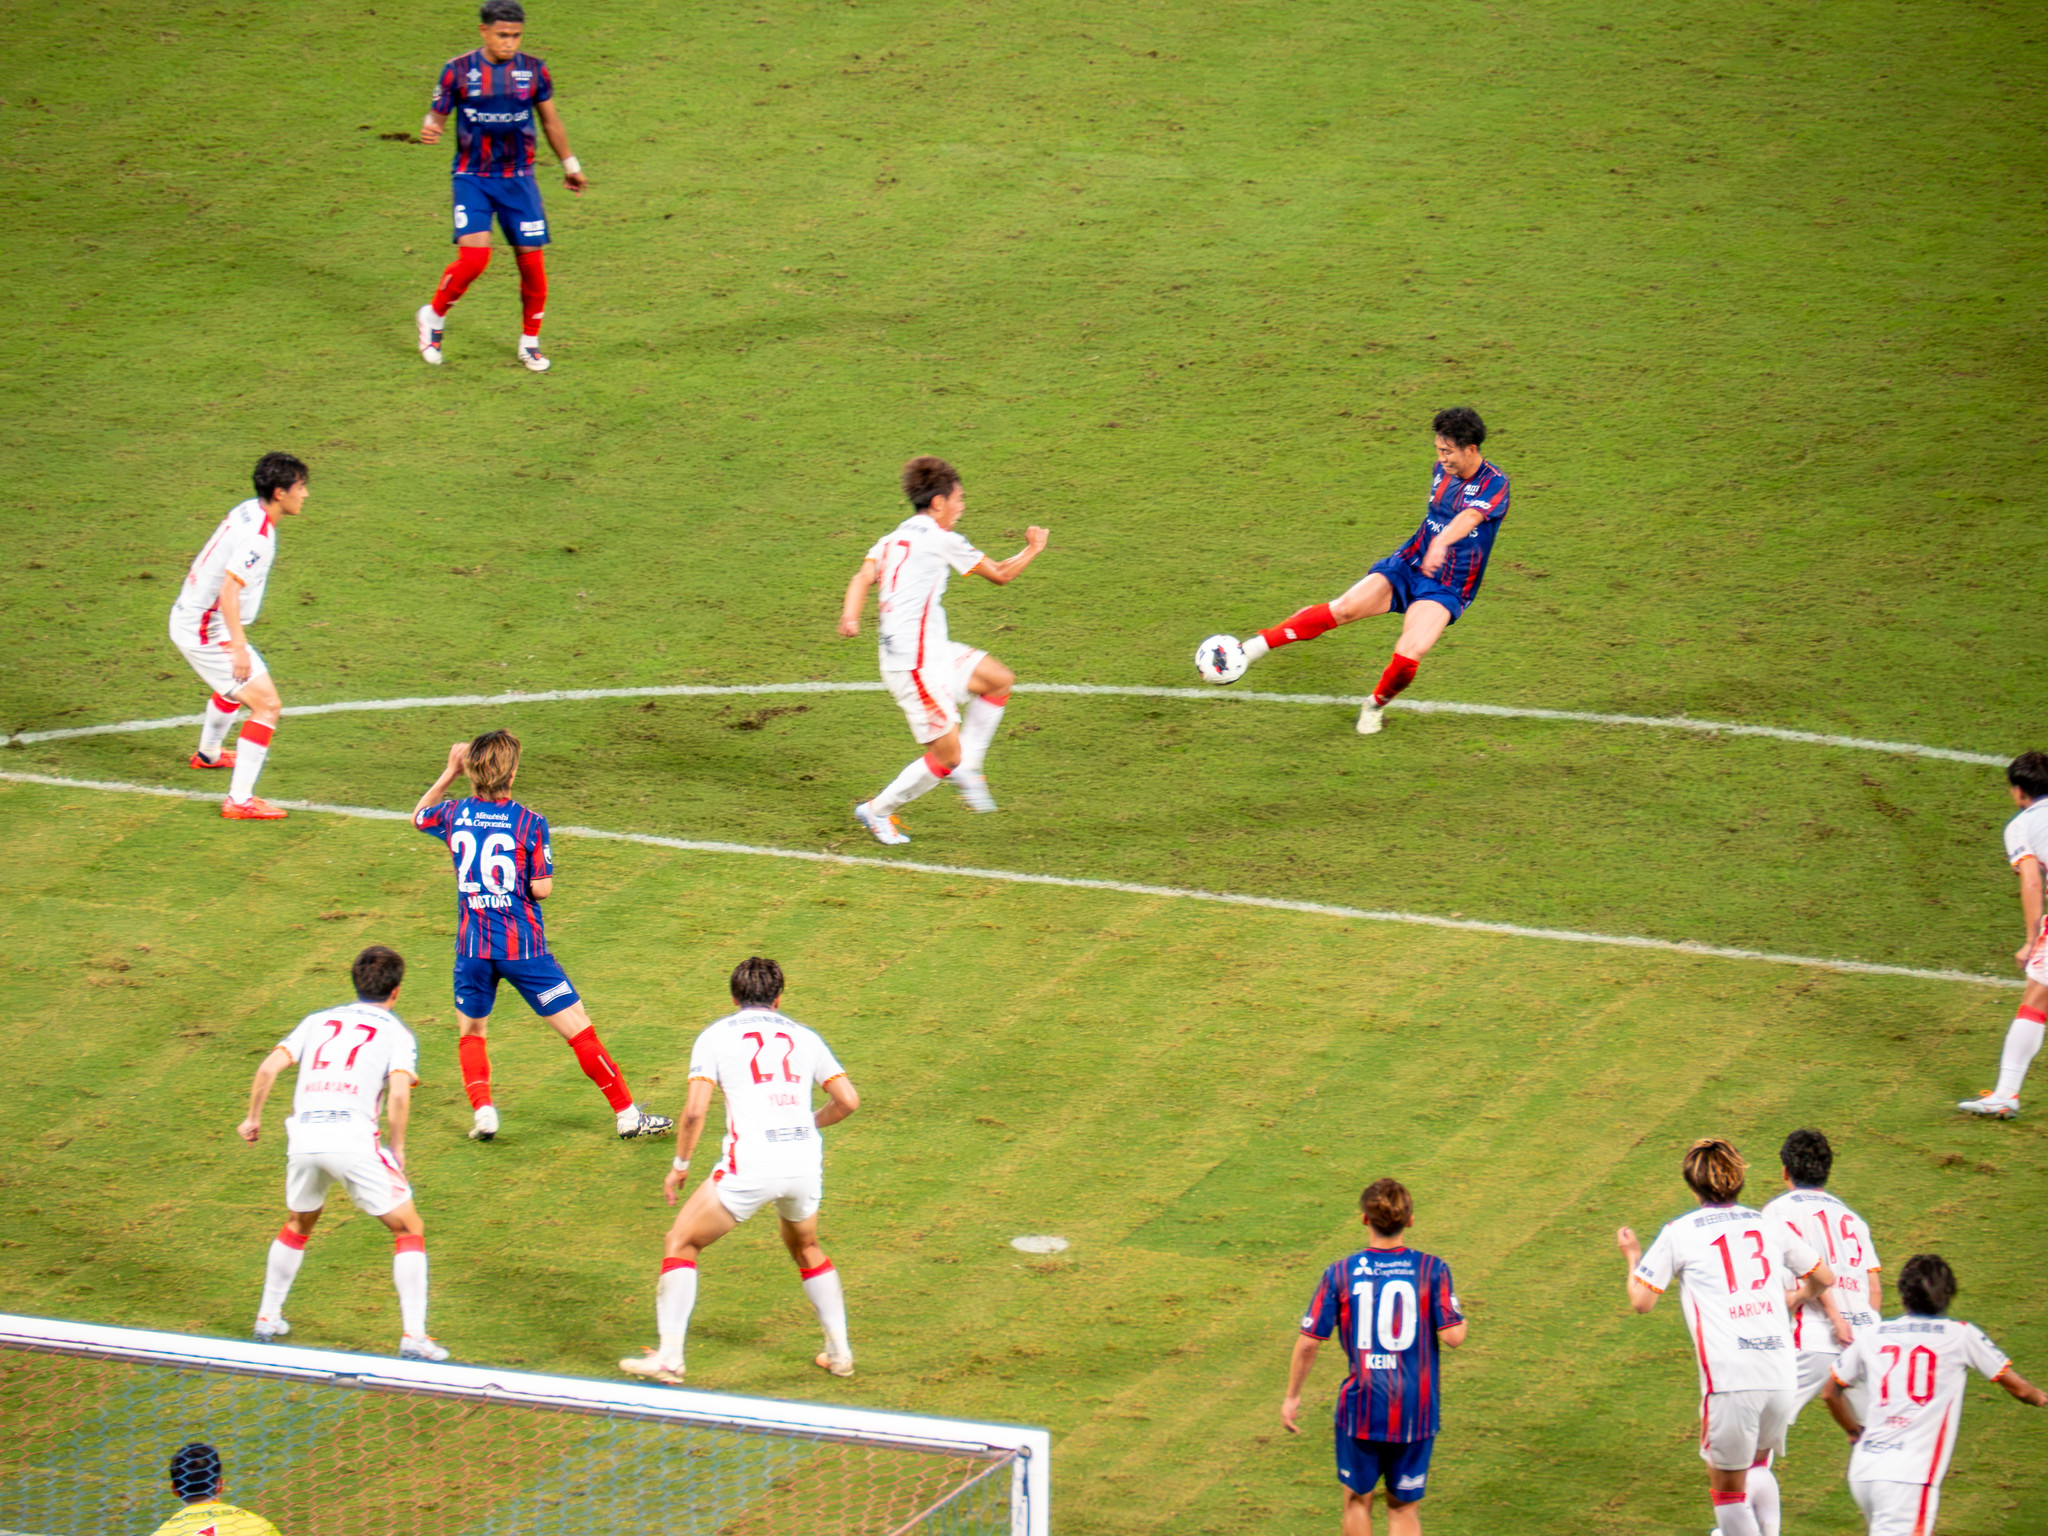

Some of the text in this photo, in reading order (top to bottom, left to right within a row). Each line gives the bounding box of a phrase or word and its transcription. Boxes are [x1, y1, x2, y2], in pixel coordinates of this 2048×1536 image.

[454, 205, 468, 229] 6
[451, 831, 516, 895] 26
[311, 1019, 378, 1071] 27
[742, 1031, 801, 1085] 22
[1710, 1229, 1771, 1294] 13
[1812, 1209, 1862, 1268] 15
[1352, 1280, 1417, 1351] 10
[1728, 1301, 1774, 1320] HARUYA
[1365, 1353, 1398, 1369] KEIN
[1878, 1344, 1937, 1407] 70
